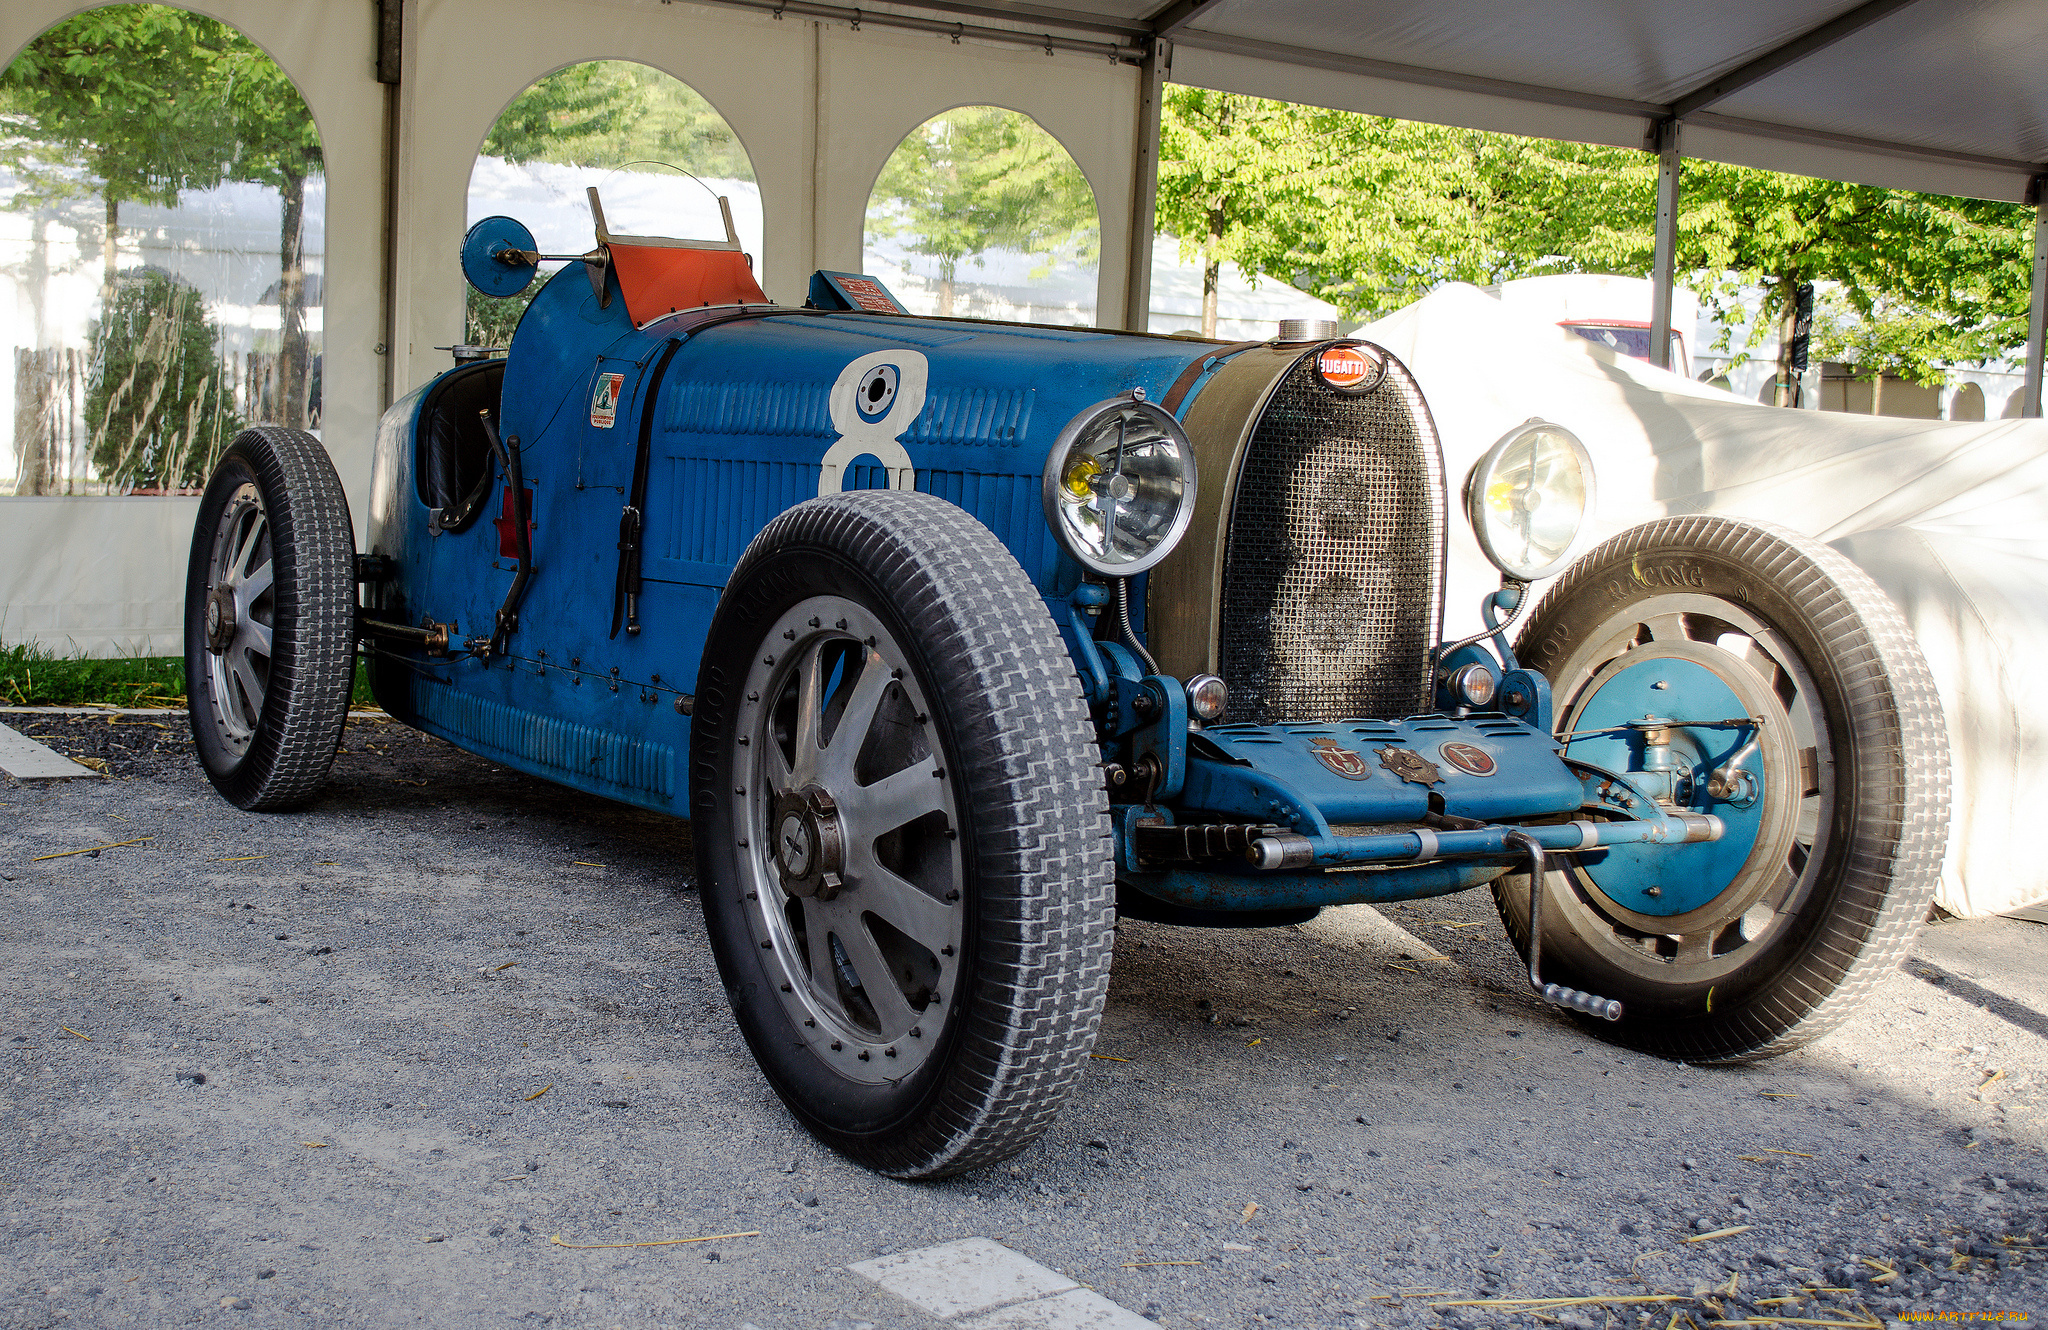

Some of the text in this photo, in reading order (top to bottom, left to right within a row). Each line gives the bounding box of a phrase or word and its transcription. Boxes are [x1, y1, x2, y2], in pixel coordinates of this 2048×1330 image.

[818, 348, 929, 497] 8
[1606, 564, 1705, 600] RACING
[696, 665, 730, 808] DUNLOP
